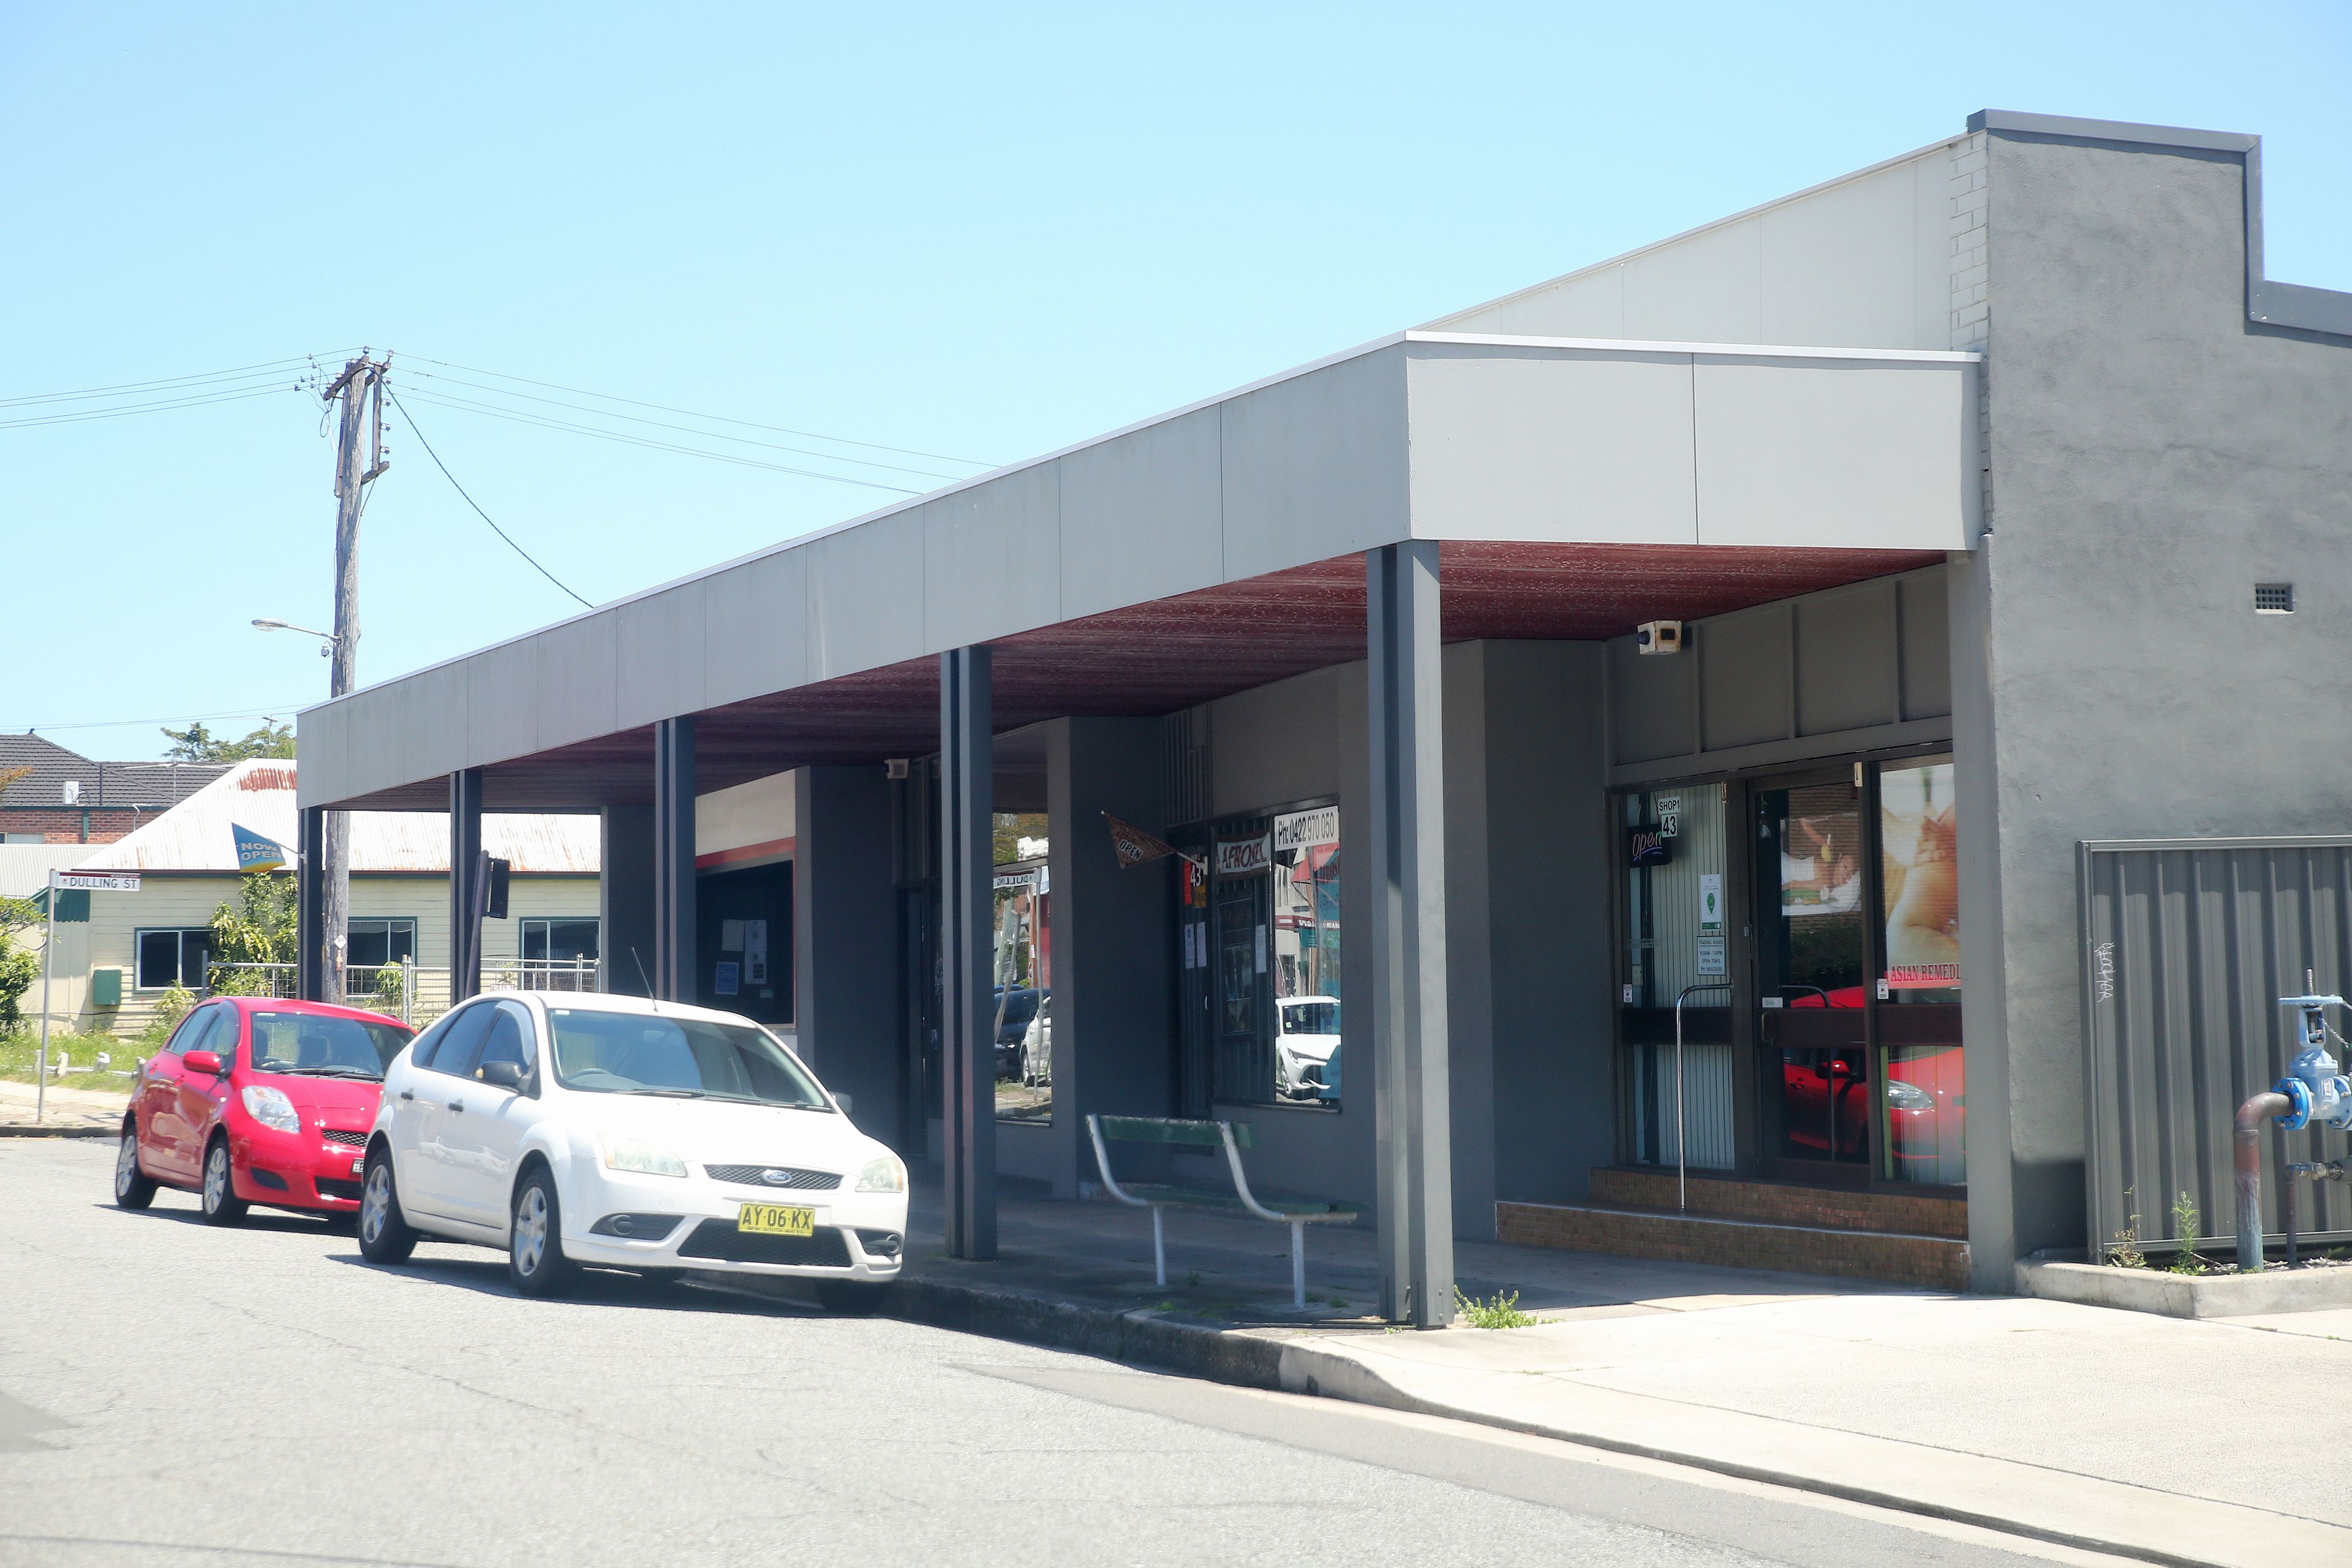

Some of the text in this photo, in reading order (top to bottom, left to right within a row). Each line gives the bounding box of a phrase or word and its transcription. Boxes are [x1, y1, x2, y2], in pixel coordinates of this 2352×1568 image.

[1290, 816, 1306, 843] 0422
[1307, 813, 1320, 842] 970
[1321, 812, 1334, 839] 050
[1662, 816, 1676, 835] 43
[240, 842, 279, 851] NOW
[1118, 840, 1142, 859] OPEN
[1632, 831, 1662, 860] Open
[240, 851, 283, 861] OPEN
[70, 877, 138, 888] DULLING ST
[1190, 864, 1202, 887] 43
[1891, 963, 1961, 982] ASIAN REMEDI
